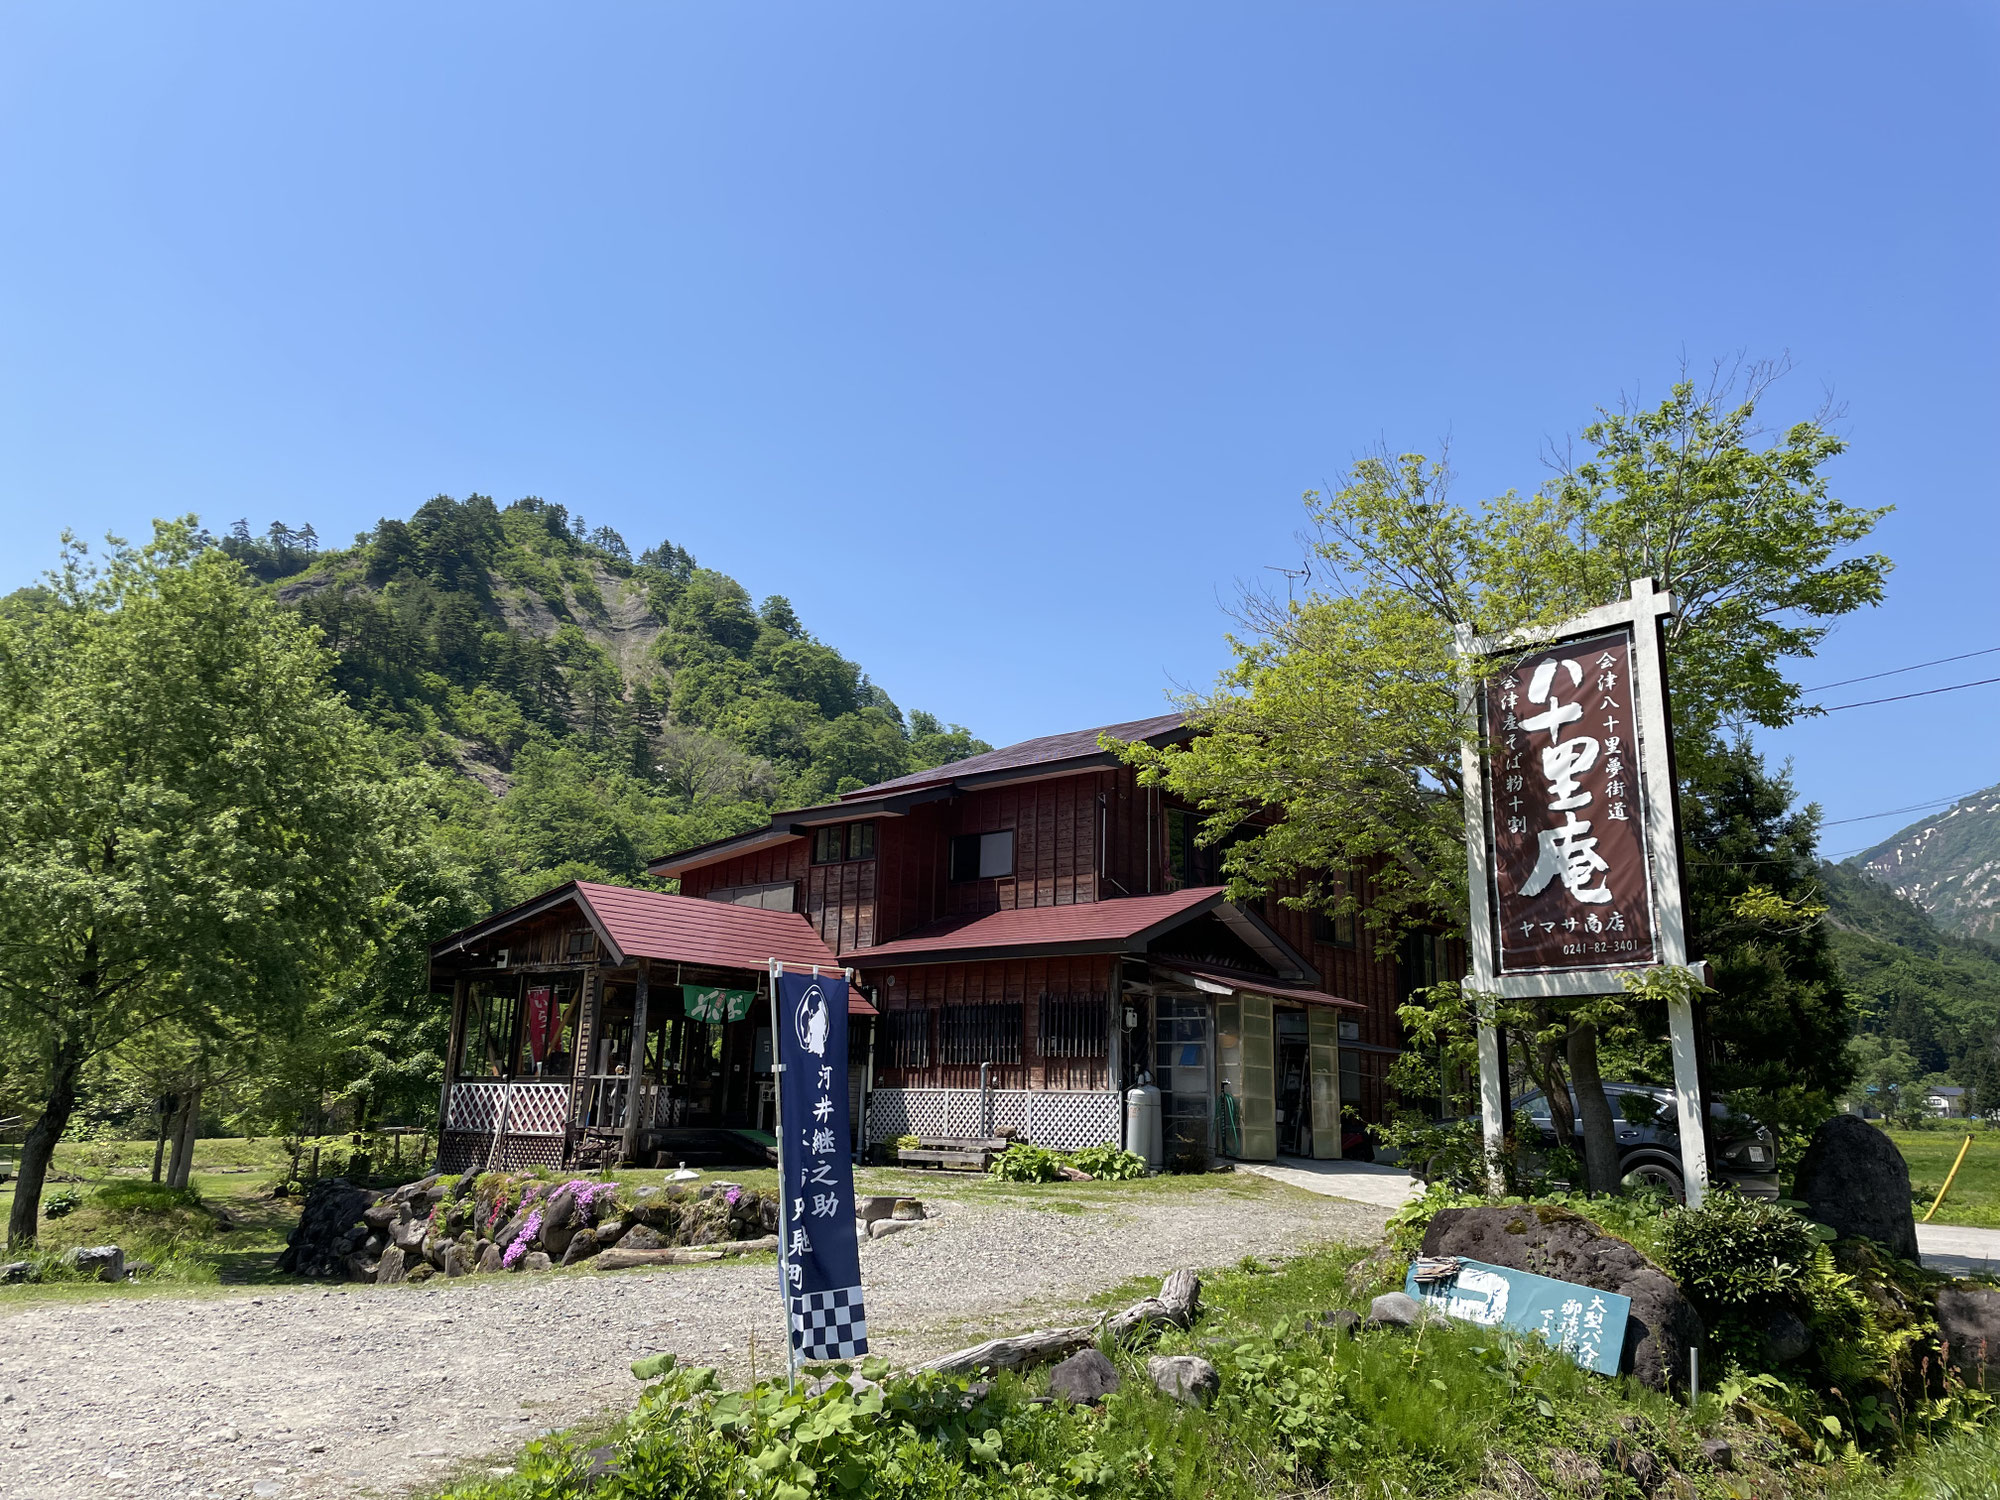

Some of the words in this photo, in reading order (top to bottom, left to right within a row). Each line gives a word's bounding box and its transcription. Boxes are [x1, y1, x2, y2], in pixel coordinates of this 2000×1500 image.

[1500, 674, 1527, 834] 会津産そば粉十割
[1517, 657, 1613, 904] 八十里庵
[1596, 652, 1629, 821] 会津八十里夢街道
[1520, 911, 1626, 938] ヤマサ商店
[1563, 939, 1639, 955] 0241-82-3401
[810, 1063, 839, 1218] 河井継之助
[1578, 1295, 1608, 1368] 大型バスは
